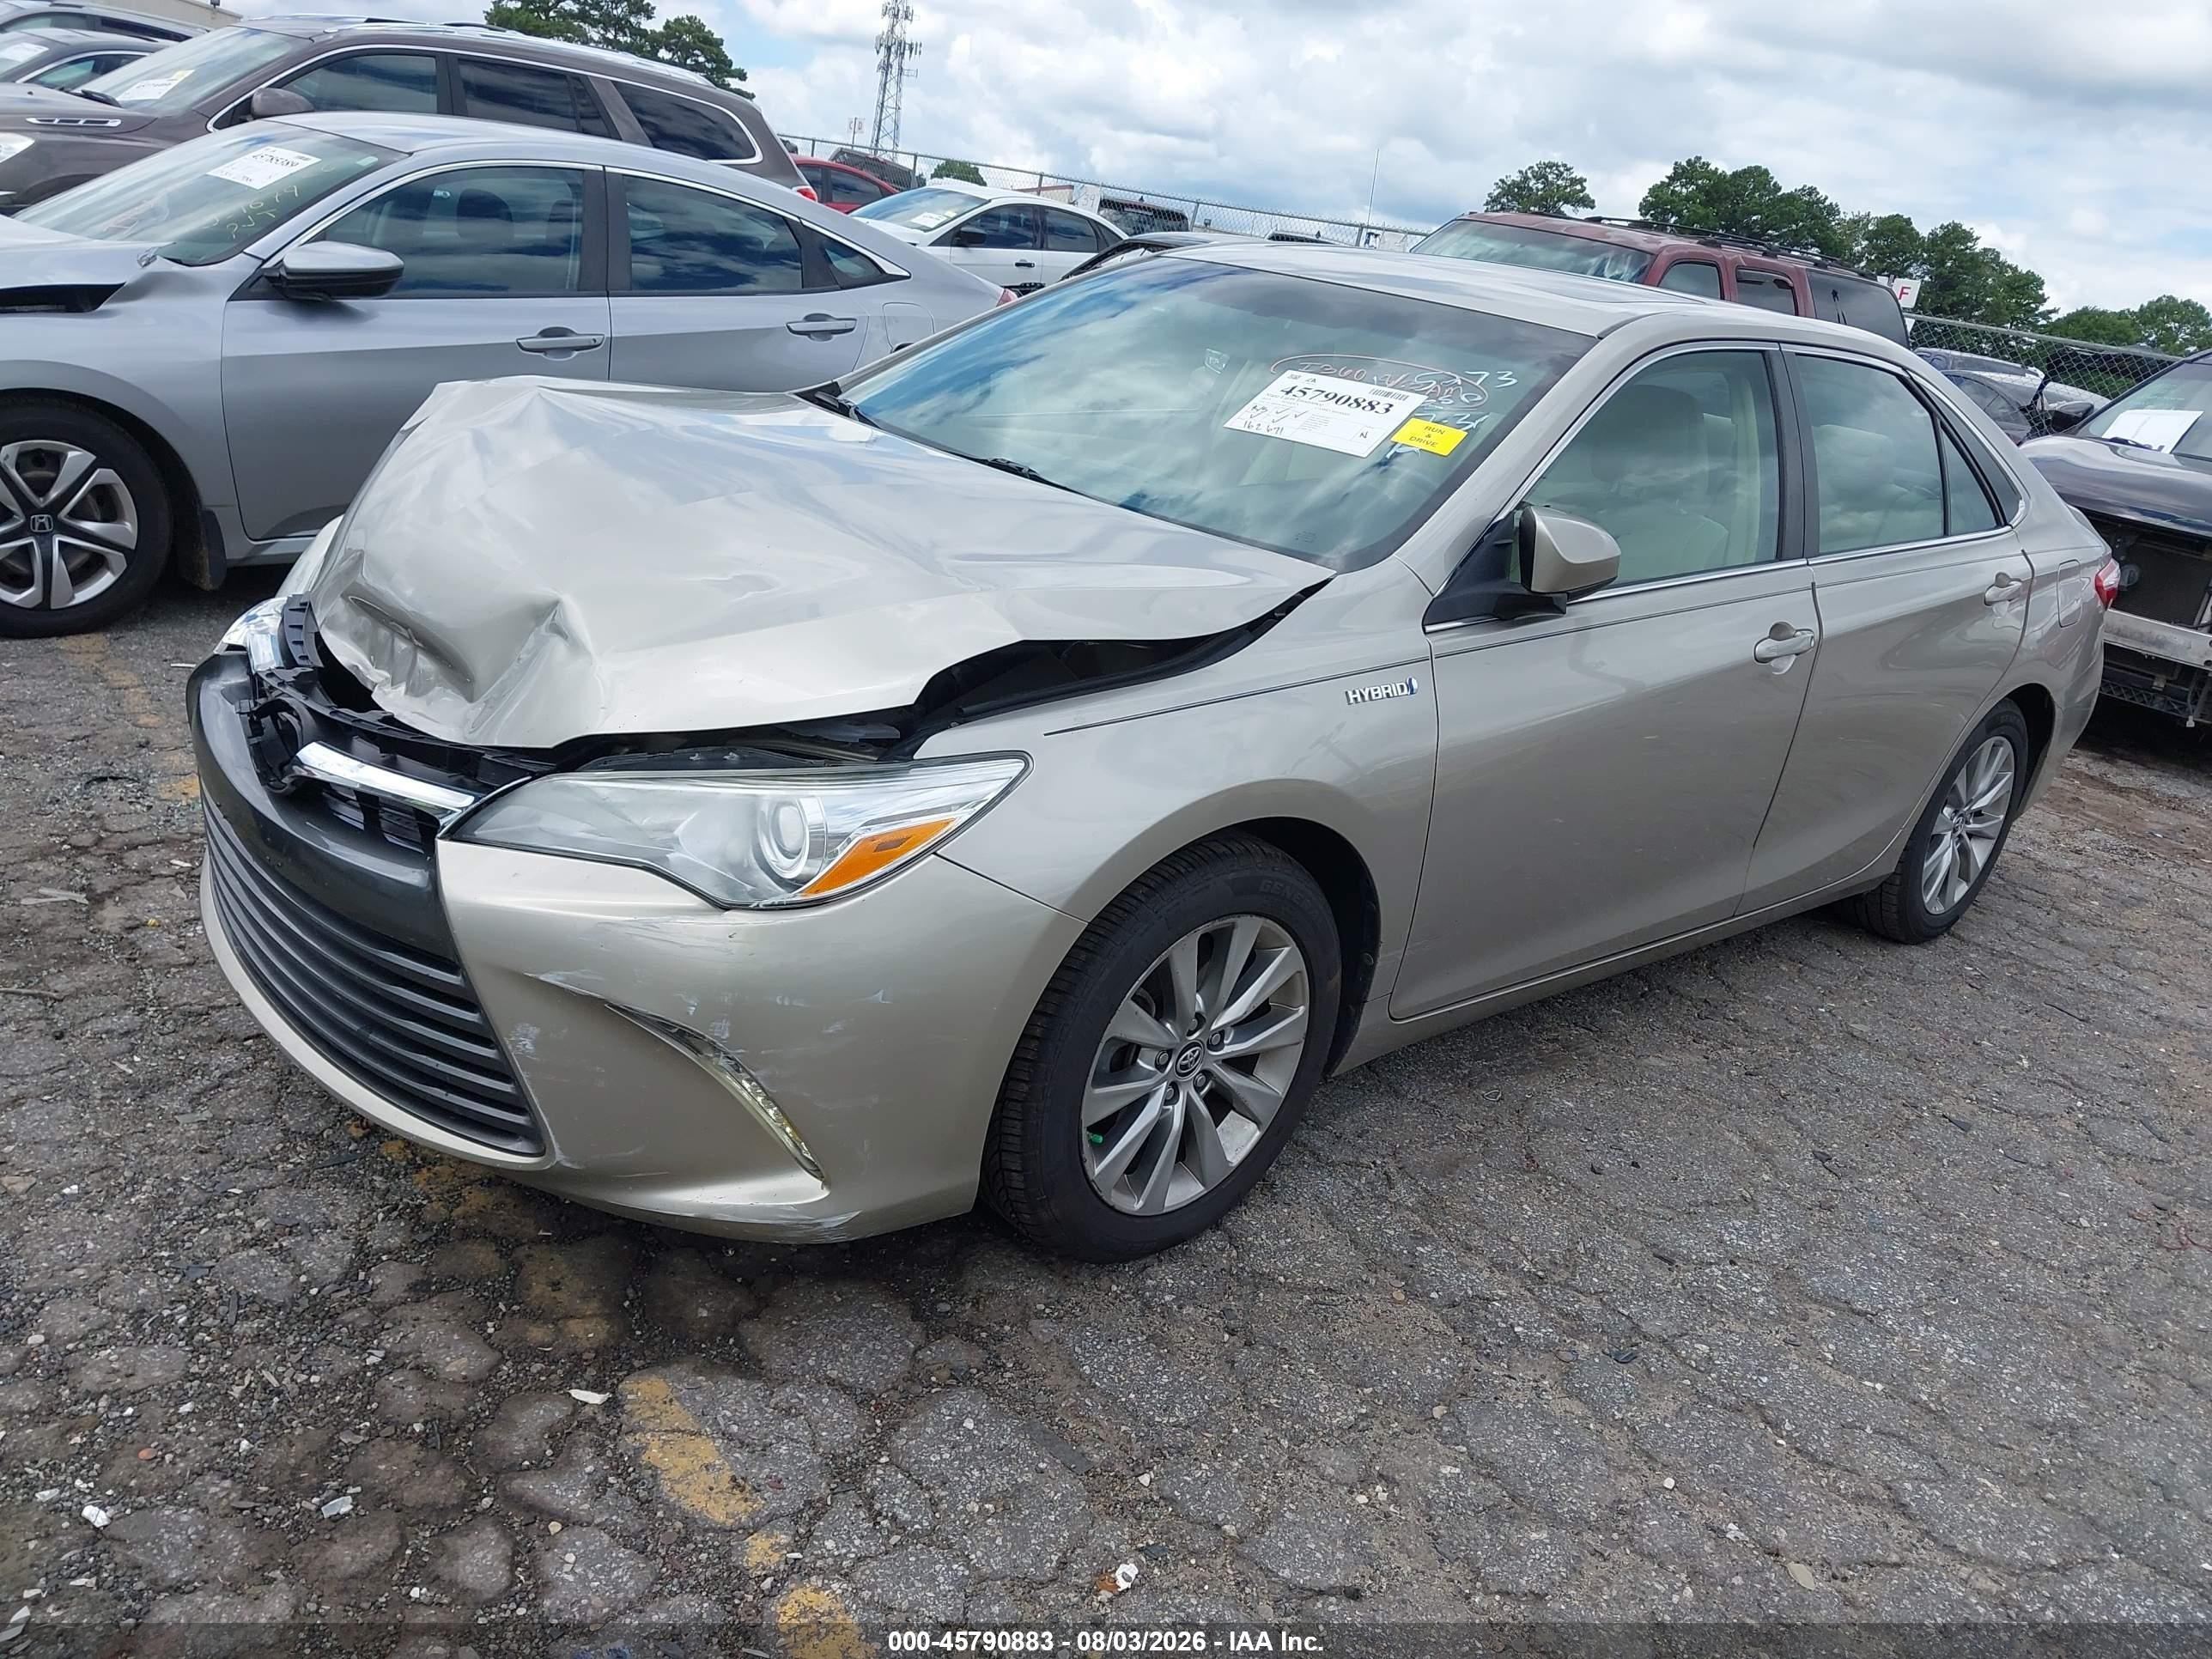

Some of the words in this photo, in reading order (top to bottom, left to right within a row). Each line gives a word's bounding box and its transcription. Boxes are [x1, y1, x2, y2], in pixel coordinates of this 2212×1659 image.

[1898, 286, 1911, 301] F
[1280, 385, 1395, 416] 45790883
[1424, 425, 1446, 435] RUN
[1408, 436, 1439, 448] DRIVE
[1346, 683, 1409, 704] HYBRID
